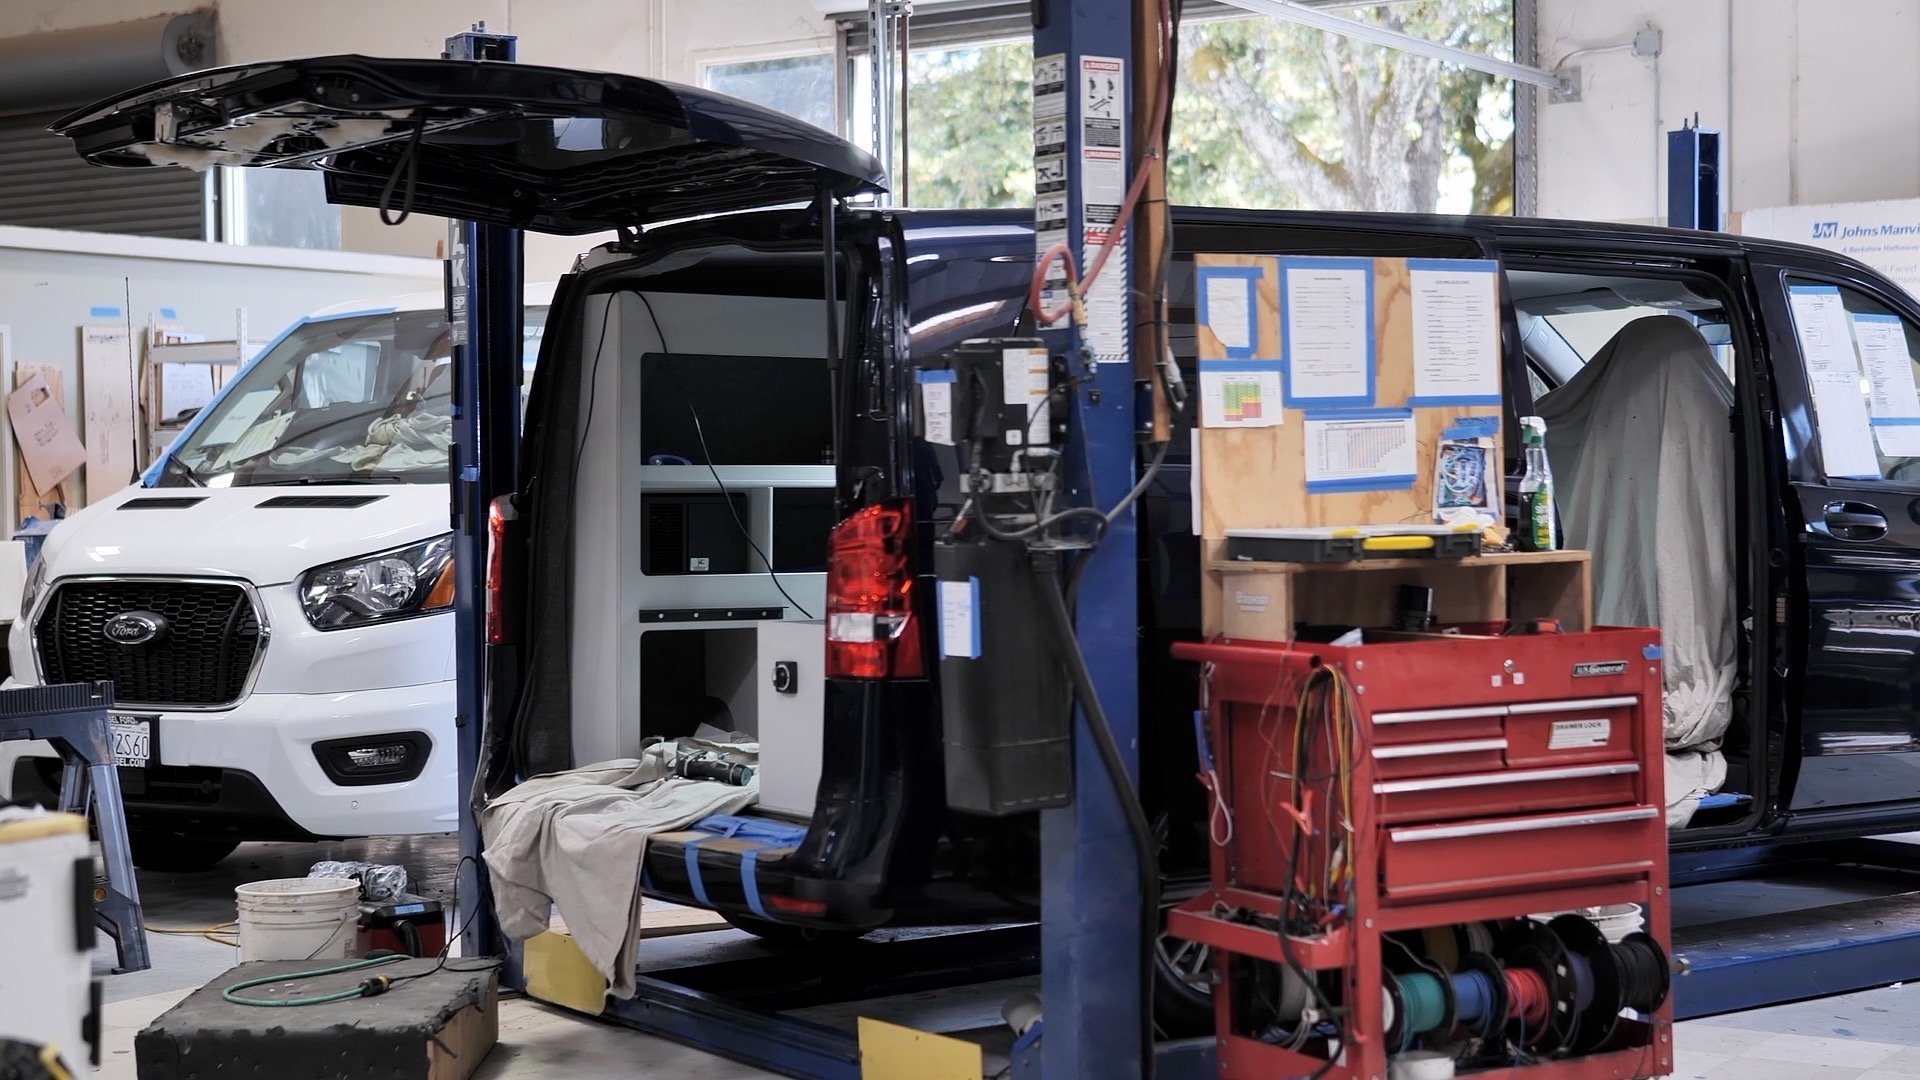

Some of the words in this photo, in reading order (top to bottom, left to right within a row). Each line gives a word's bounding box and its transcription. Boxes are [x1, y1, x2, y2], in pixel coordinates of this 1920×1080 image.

[1840, 226, 1879, 239] Johns
[112, 621, 140, 637] Ford
[111, 733, 149, 758] 2S60
